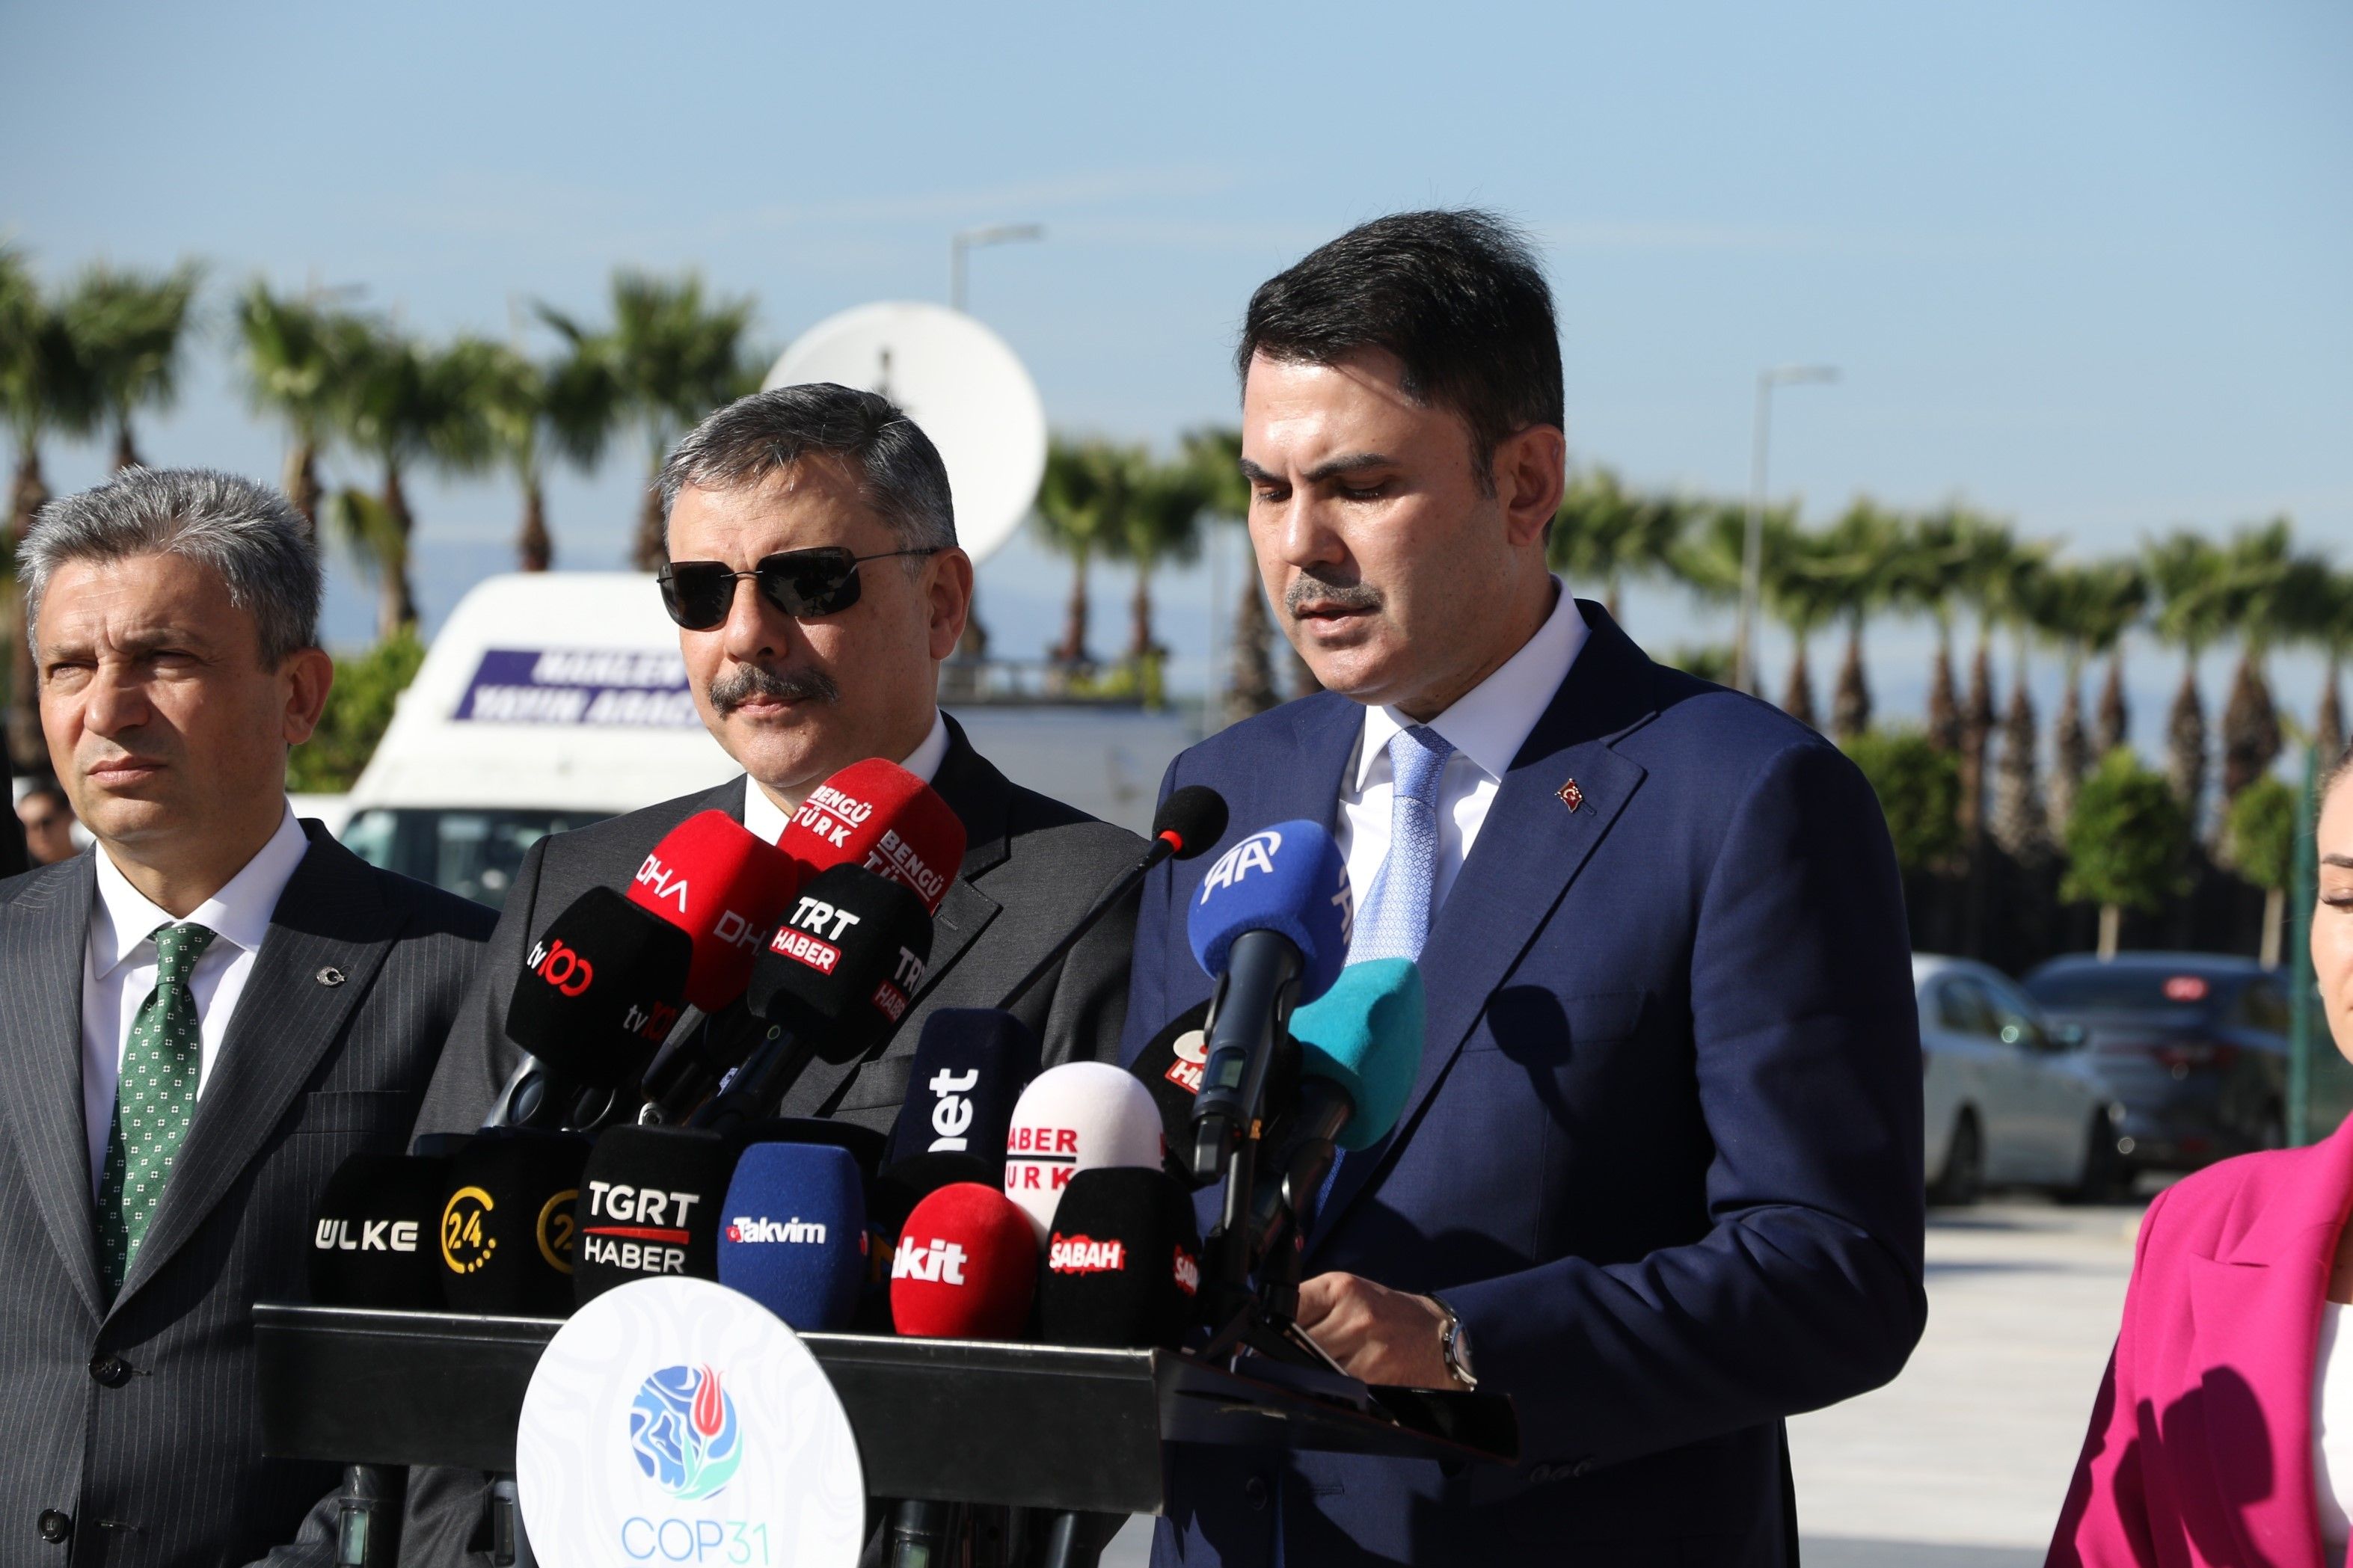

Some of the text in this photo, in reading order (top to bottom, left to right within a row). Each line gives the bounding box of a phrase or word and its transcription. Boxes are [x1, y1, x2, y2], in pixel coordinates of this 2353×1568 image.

[809, 784, 872, 823] BENGÜ
[791, 805, 851, 849] TÜRK
[636, 854, 687, 914] DHA
[880, 828, 945, 897] BENGÜ
[1200, 831, 1281, 906] AA
[713, 909, 767, 957] DH
[790, 897, 860, 941] TRT
[526, 938, 594, 997] tv100
[771, 929, 835, 971] HABER
[894, 945, 924, 994] TR
[623, 1000, 677, 1046] tv10
[1007, 1128, 1078, 1154] ABER
[1007, 1166, 1075, 1190] URK
[589, 1180, 700, 1228] TGRT
[448, 1209, 482, 1249] 24
[553, 1213, 574, 1250] 2
[732, 1217, 826, 1244] Takvim
[584, 1236, 686, 1273] HABER
[1049, 1242, 1121, 1269] SABAH
[622, 1516, 770, 1567] COP31
